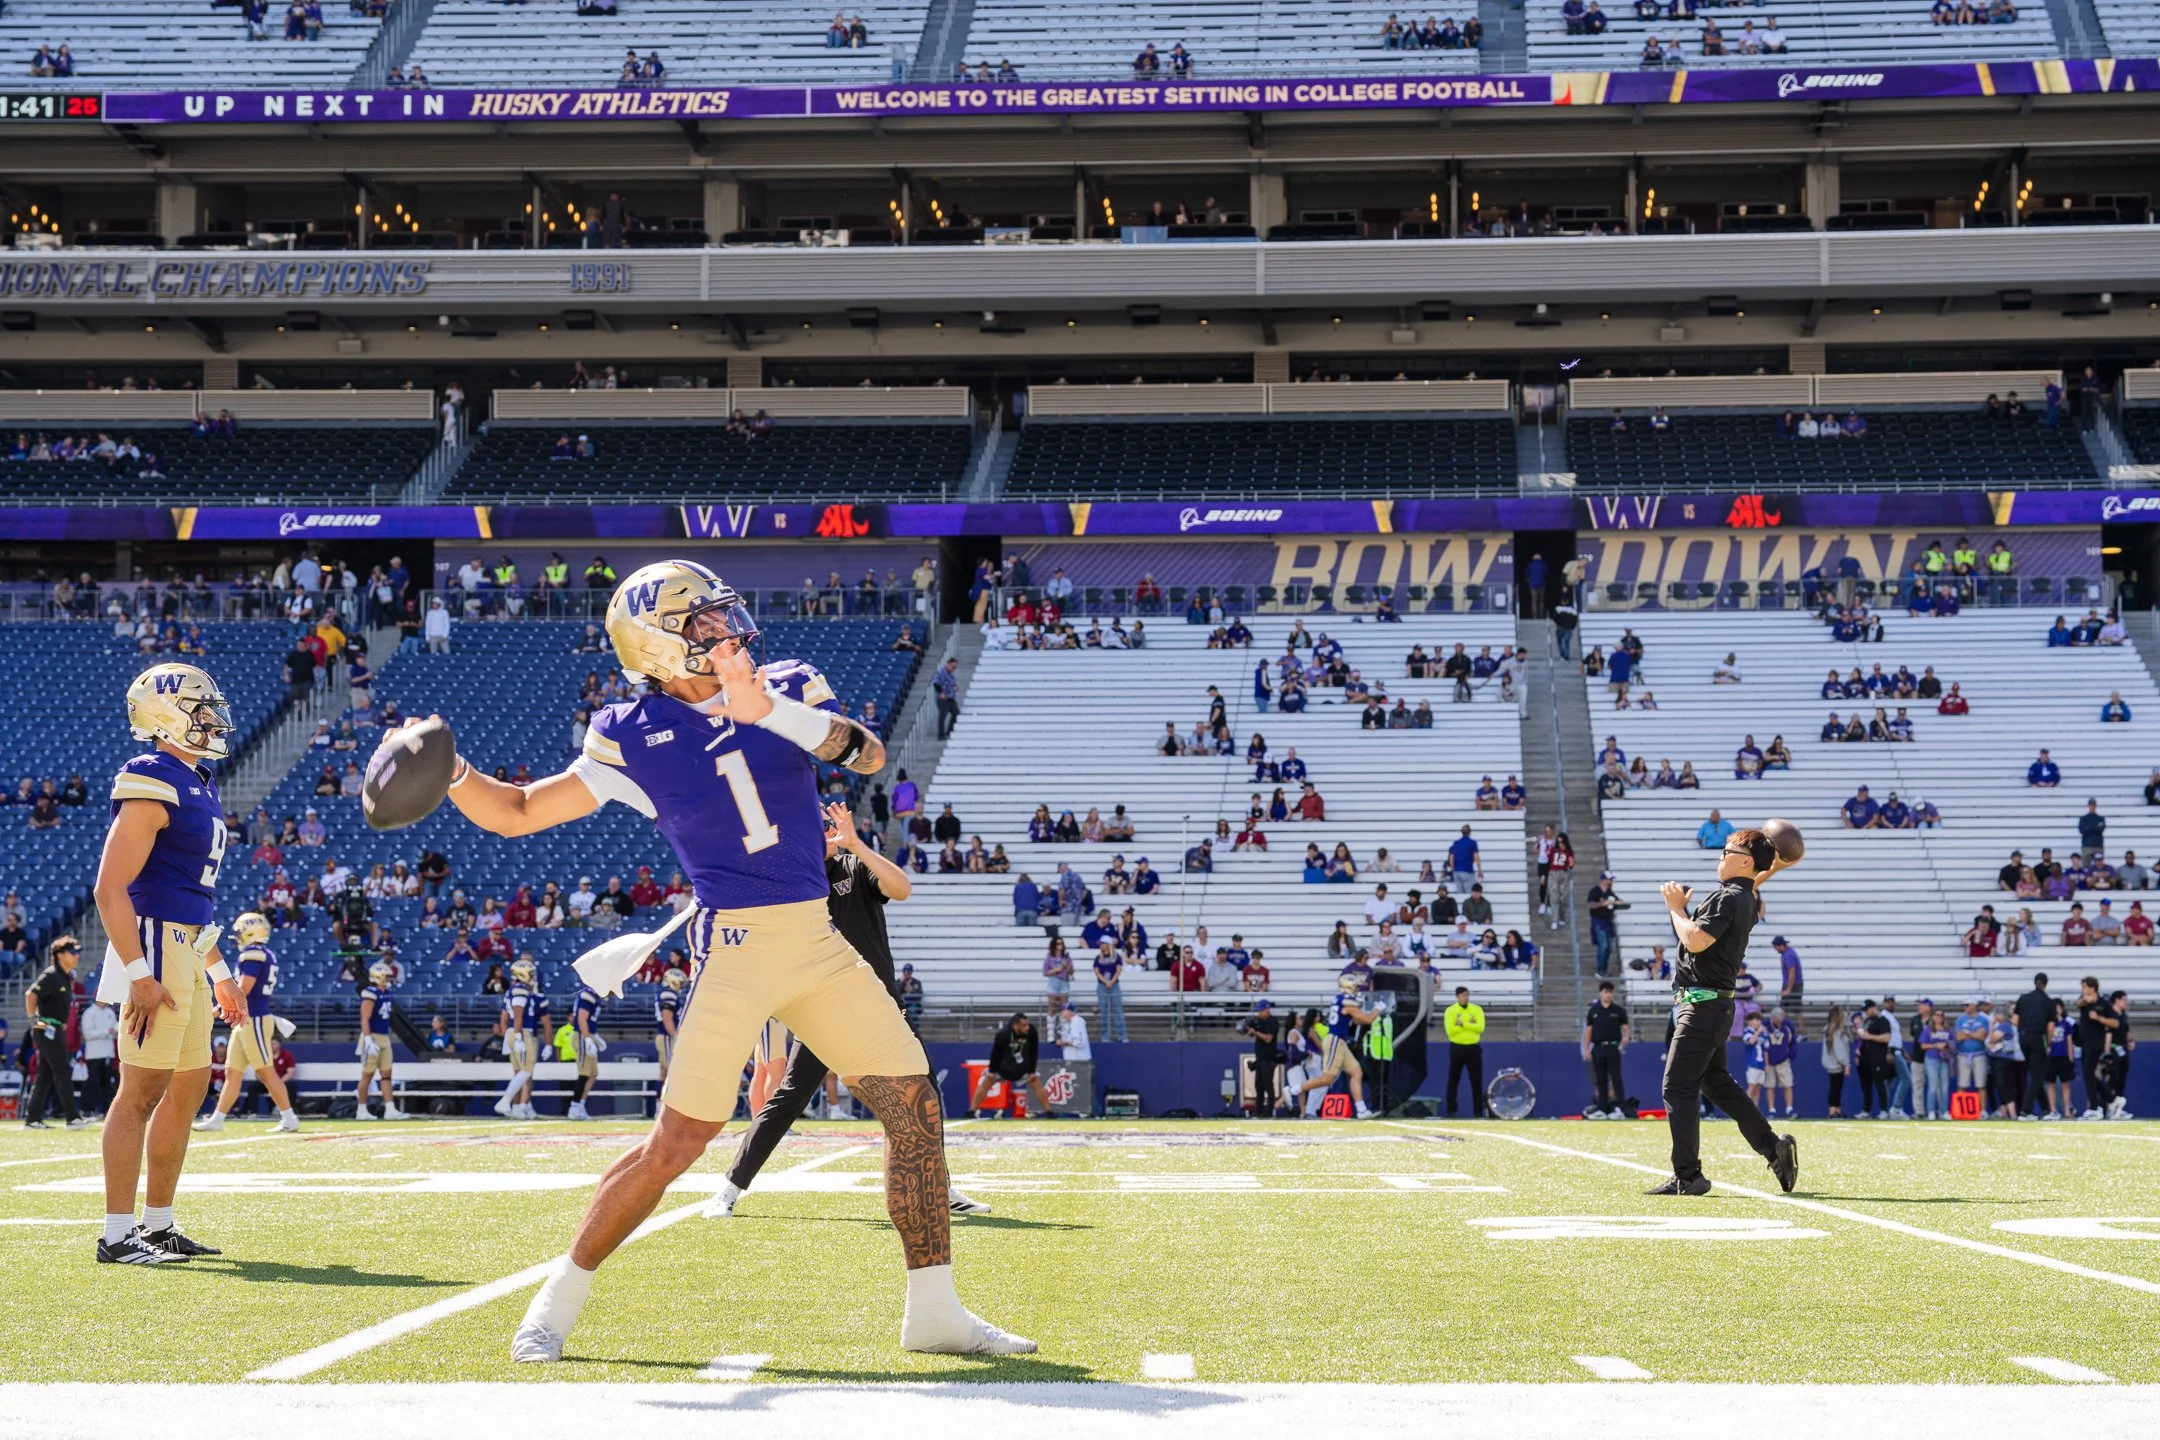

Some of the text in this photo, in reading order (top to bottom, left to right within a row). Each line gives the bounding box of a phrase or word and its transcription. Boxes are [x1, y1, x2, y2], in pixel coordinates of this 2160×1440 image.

[1802, 73, 1884, 87] BOEING
[184, 90, 731, 117] UP NEXT IN HUSKY ATHLETICS
[835, 81, 1525, 109] WELCOME TO THE GREATEST SETTING IN COLLEGE FOOTBALL
[0, 96, 98, 117] 1:41 25
[150, 261, 432, 296] CHAMPIONS
[570, 261, 631, 292] 1991
[303, 514, 381, 526] BOEING
[1204, 509, 1283, 522] BOEING
[1256, 533, 1917, 613] BOW DOWN
[624, 578, 665, 617] W
[153, 673, 187, 695] W
[715, 749, 779, 855] 1
[833, 878, 852, 896] W
[172, 928, 187, 945] W
[721, 926, 749, 946] W
[1325, 1098, 1344, 1116] 20
[1956, 1096, 1976, 1115] 10
